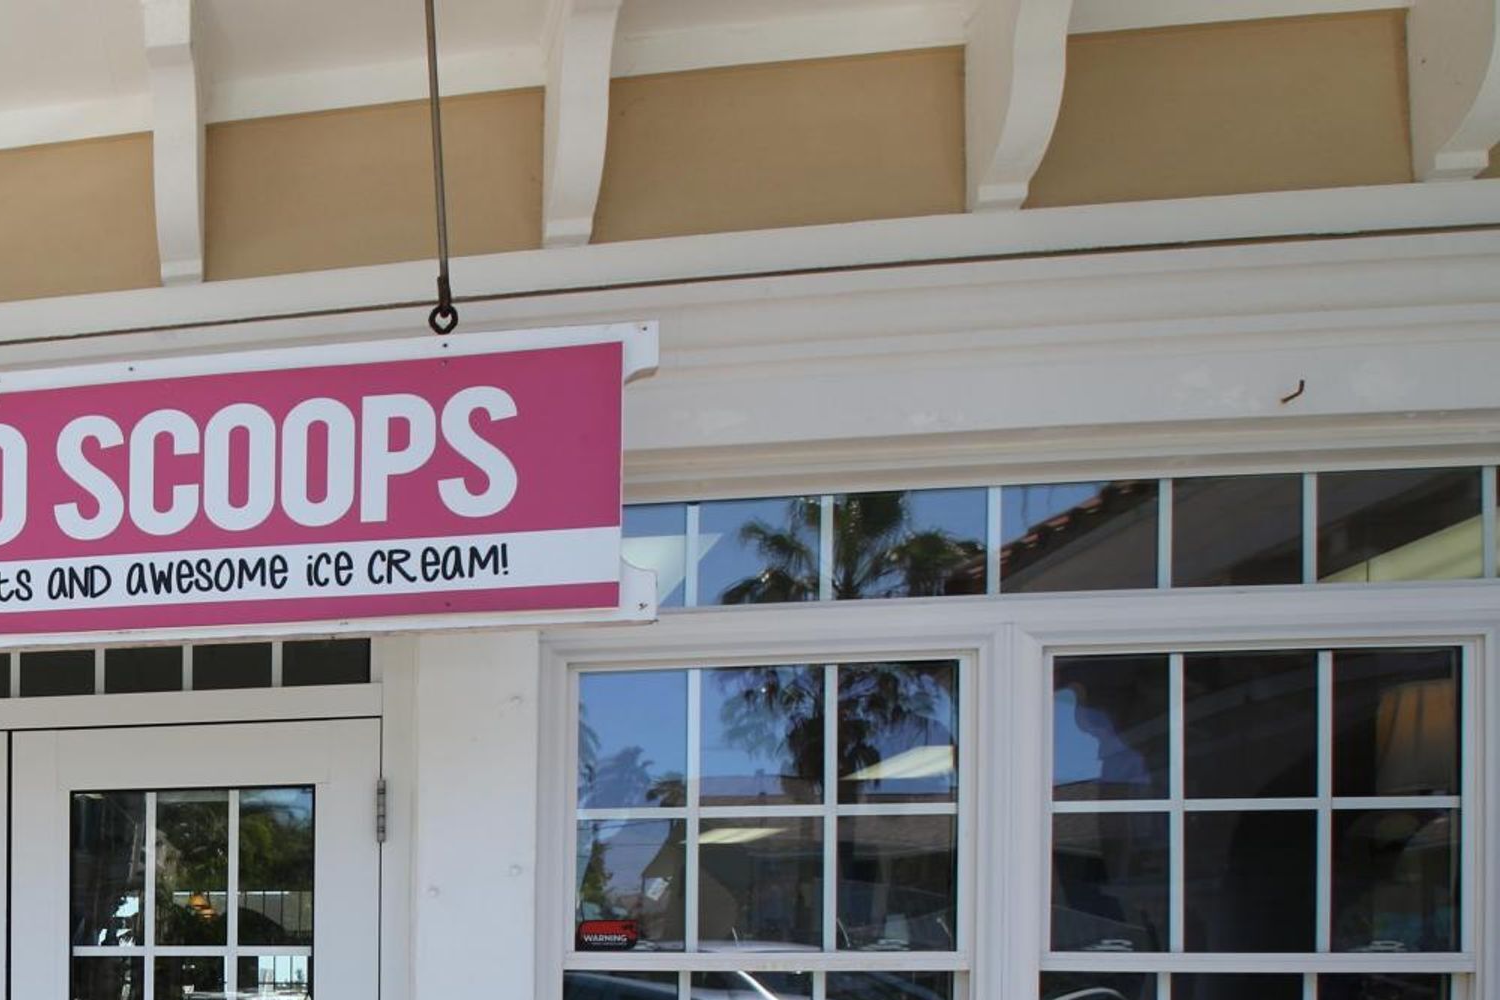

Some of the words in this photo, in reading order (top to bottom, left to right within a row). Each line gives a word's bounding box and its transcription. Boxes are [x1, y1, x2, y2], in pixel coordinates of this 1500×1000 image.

[53, 385, 518, 542] SCOOPS
[305, 551, 354, 587] ice
[583, 934, 628, 942] WARNING
